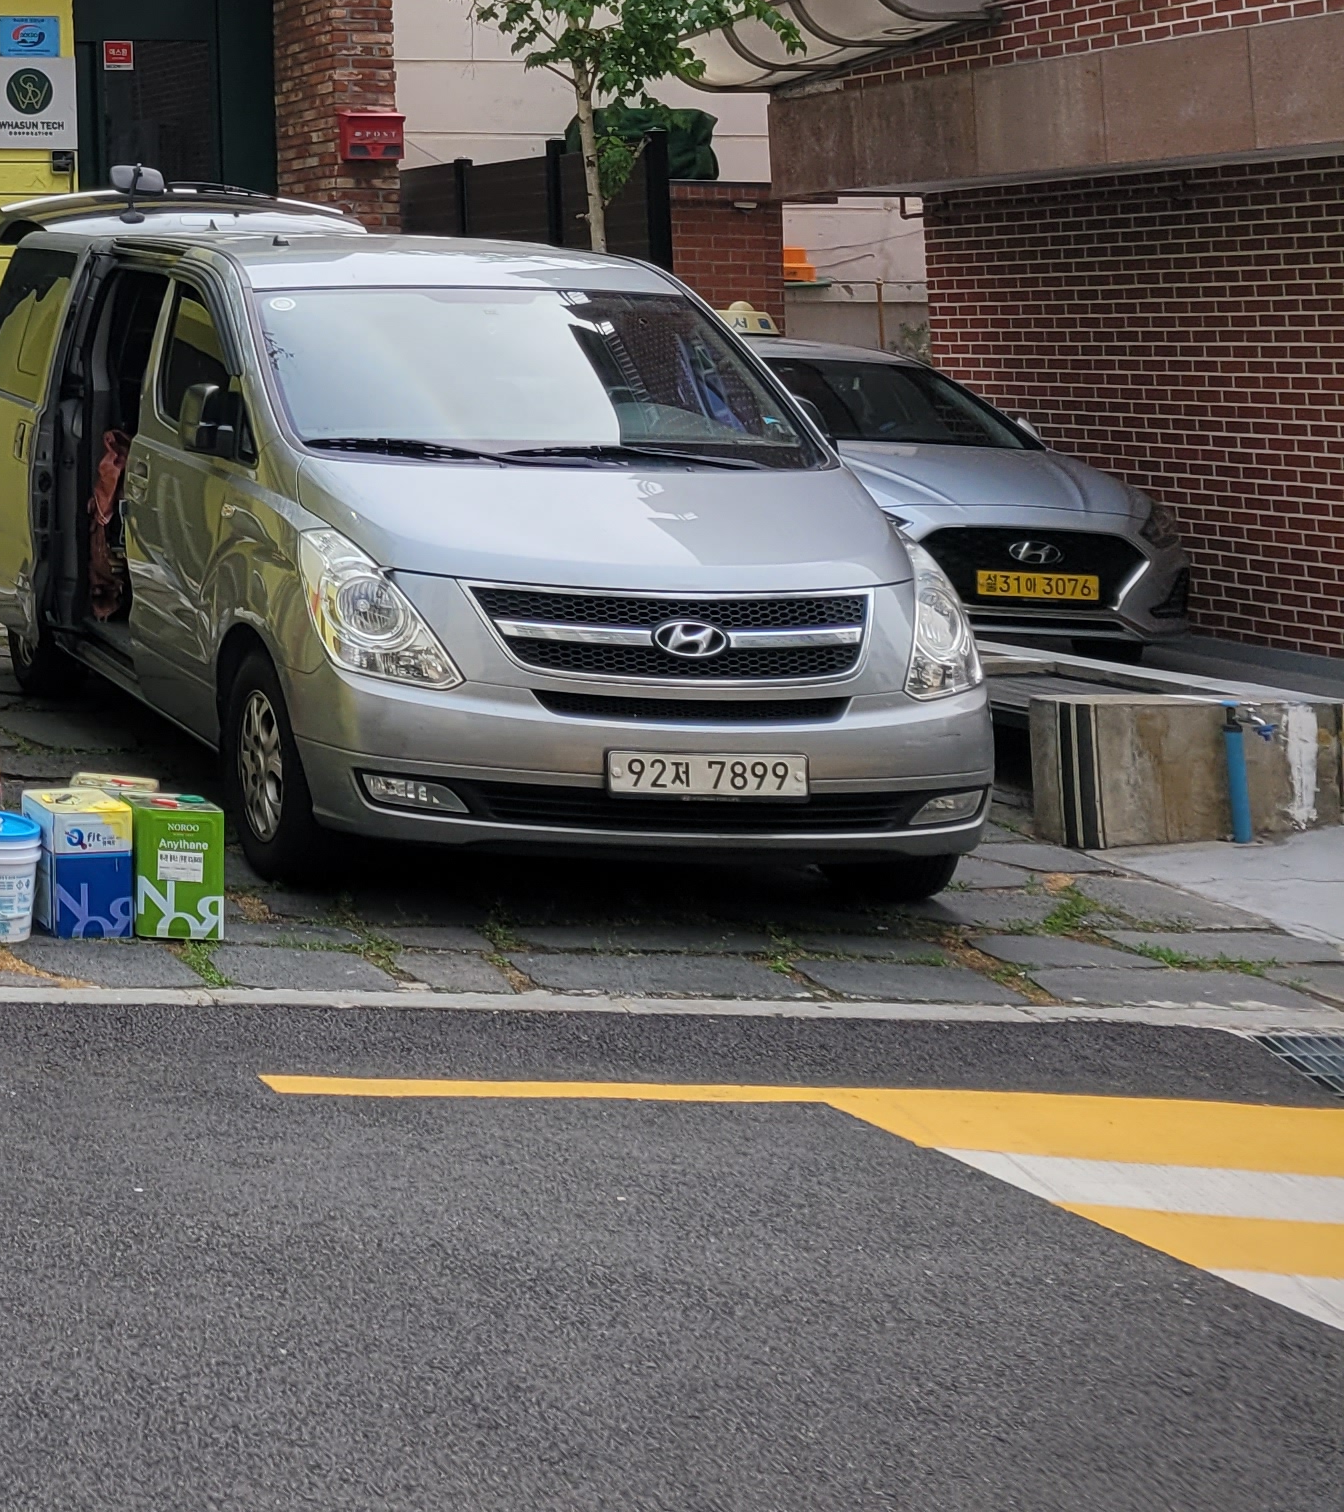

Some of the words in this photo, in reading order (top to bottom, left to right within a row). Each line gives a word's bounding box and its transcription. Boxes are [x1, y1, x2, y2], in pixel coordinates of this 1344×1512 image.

[40, 121, 65, 130] TECH
[999, 574, 1036, 593] 31아
[1042, 576, 1092, 597] 3076
[627, 758, 691, 789] 92저
[707, 760, 789, 791] 7899
[167, 822, 200, 832] NOROO
